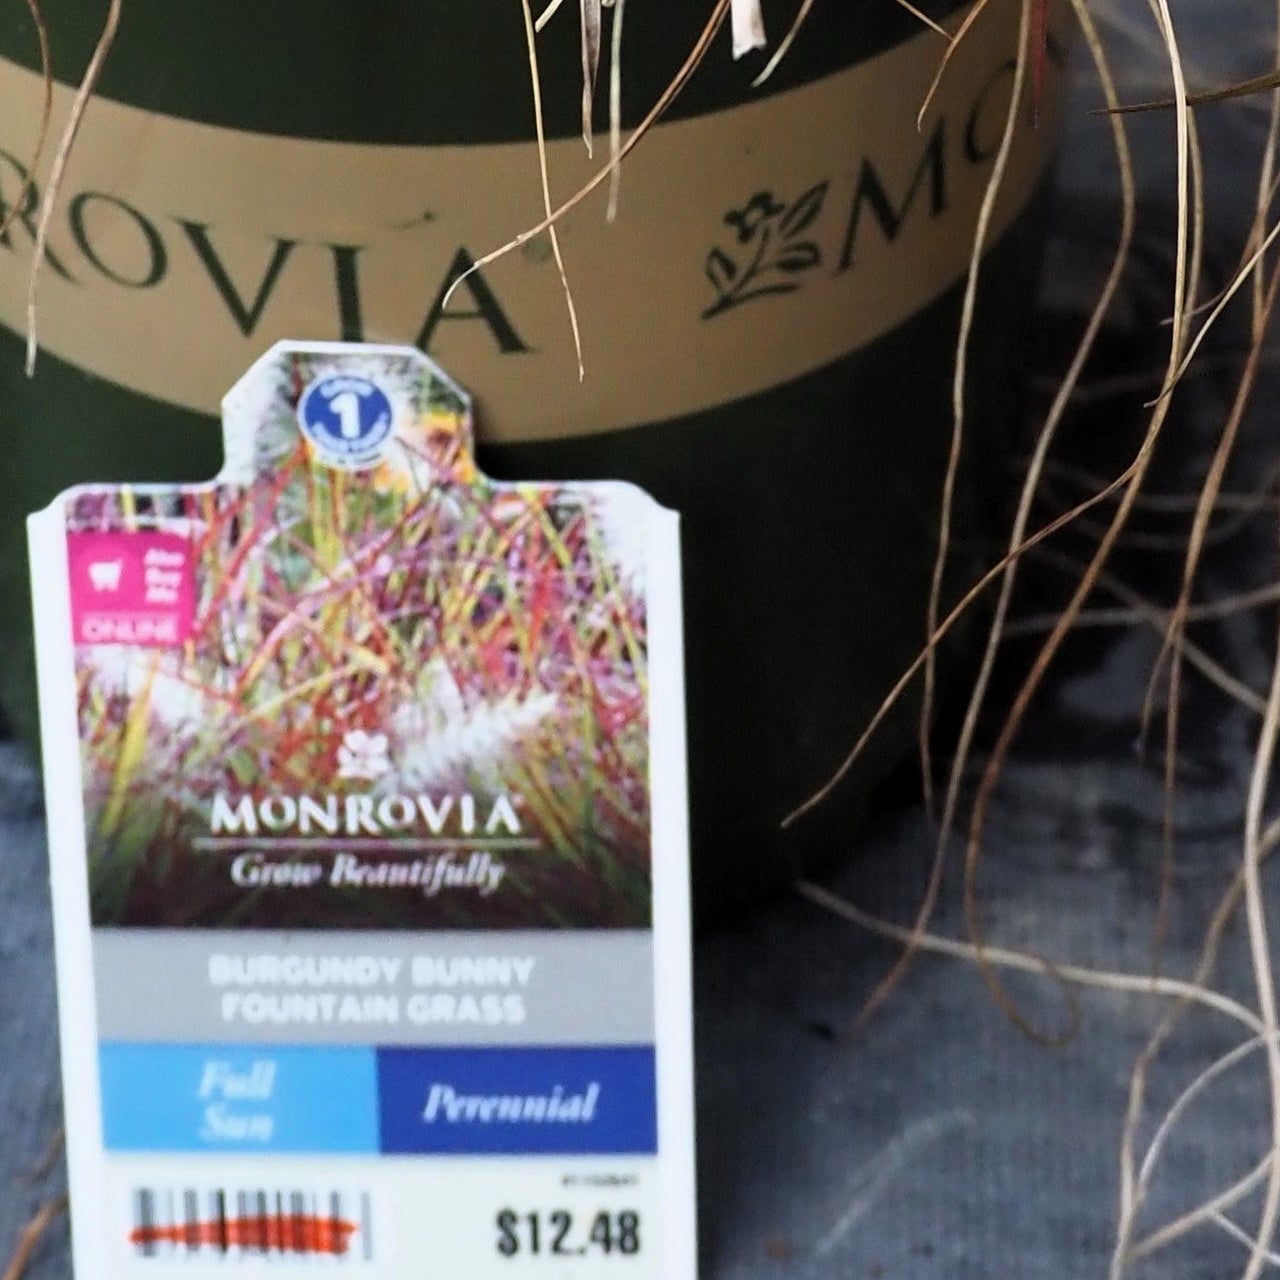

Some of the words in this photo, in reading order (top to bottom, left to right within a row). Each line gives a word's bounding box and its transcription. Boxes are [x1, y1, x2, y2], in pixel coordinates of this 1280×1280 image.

[329, 392, 361, 439] 1
[210, 793, 522, 836] MONROVIA
[230, 852, 322, 888] Grow
[329, 850, 506, 898] Beautifully
[207, 954, 403, 986] BURGUNDY
[411, 955, 536, 987] BUNNY
[220, 991, 401, 1024] FOUNTAIN
[406, 992, 526, 1024] GRASS
[200, 1060, 277, 1101] Full
[422, 1082, 600, 1124] Perennial
[495, 1207, 641, 1258] $12.48
